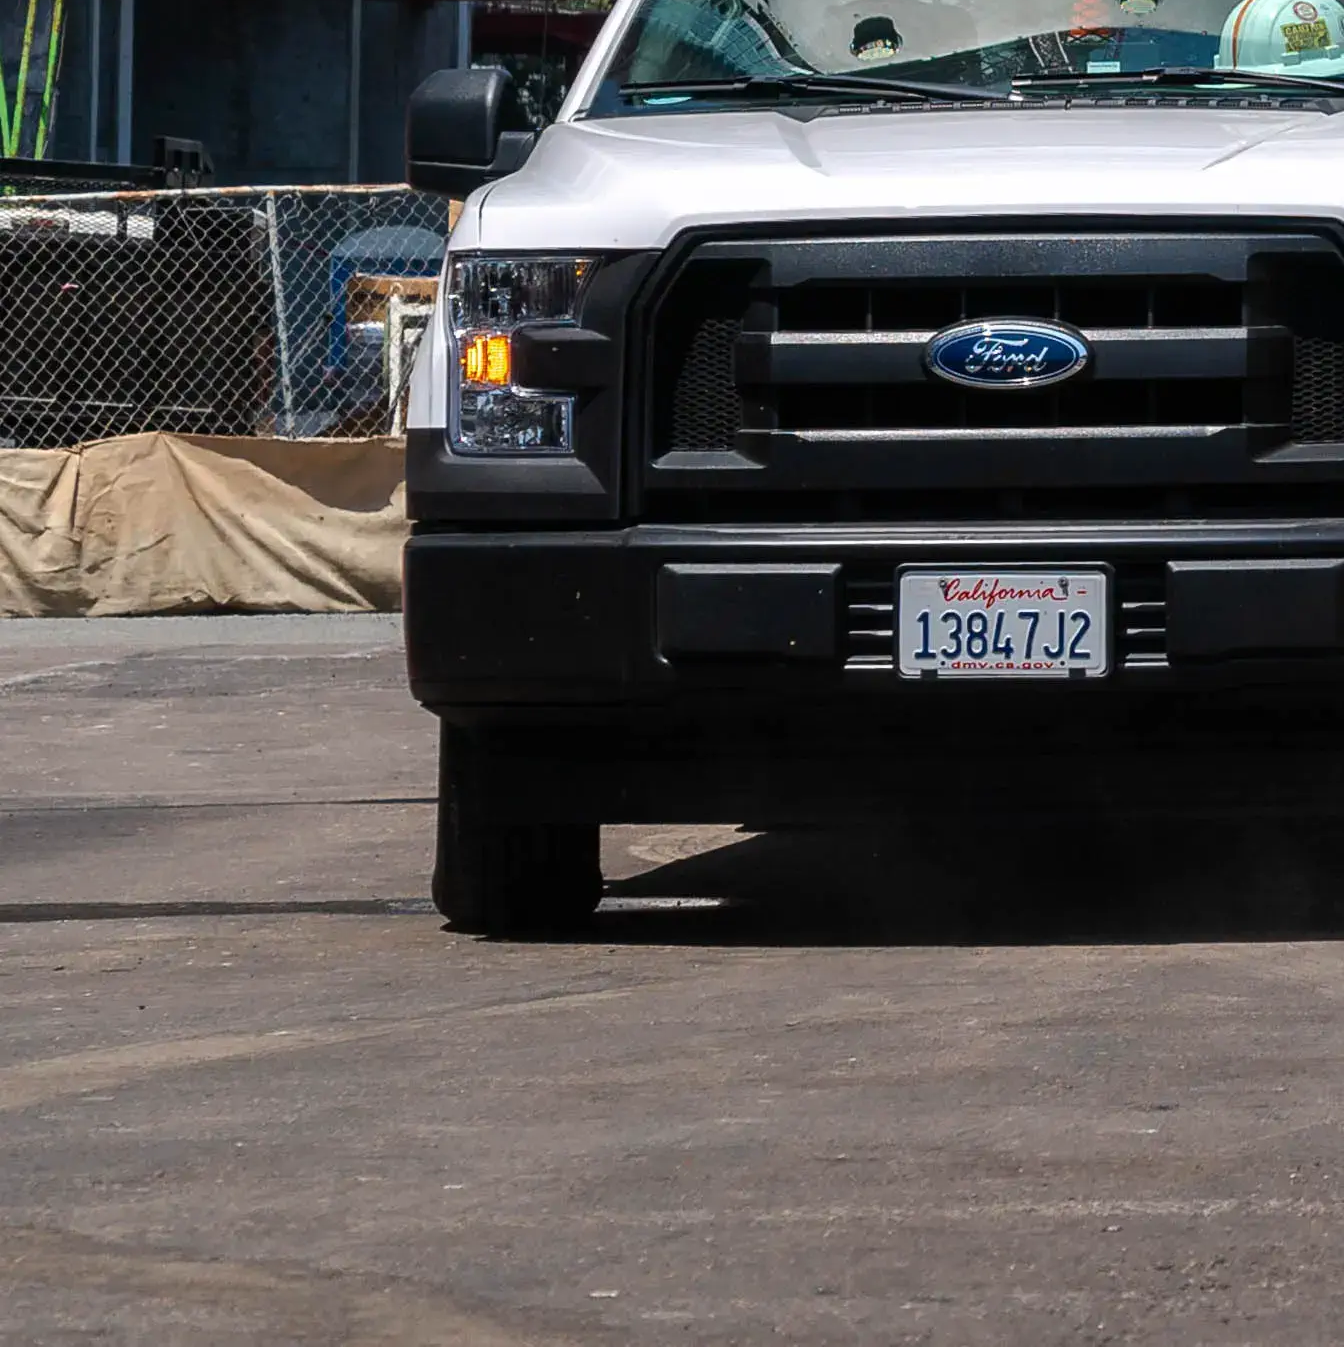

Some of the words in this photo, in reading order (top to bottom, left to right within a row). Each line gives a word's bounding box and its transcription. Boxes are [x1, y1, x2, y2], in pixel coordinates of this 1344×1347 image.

[944, 578, 1067, 609] California
[914, 610, 1092, 661] 13847J2
[951, 660, 1055, 670] dmv.ca.gov
